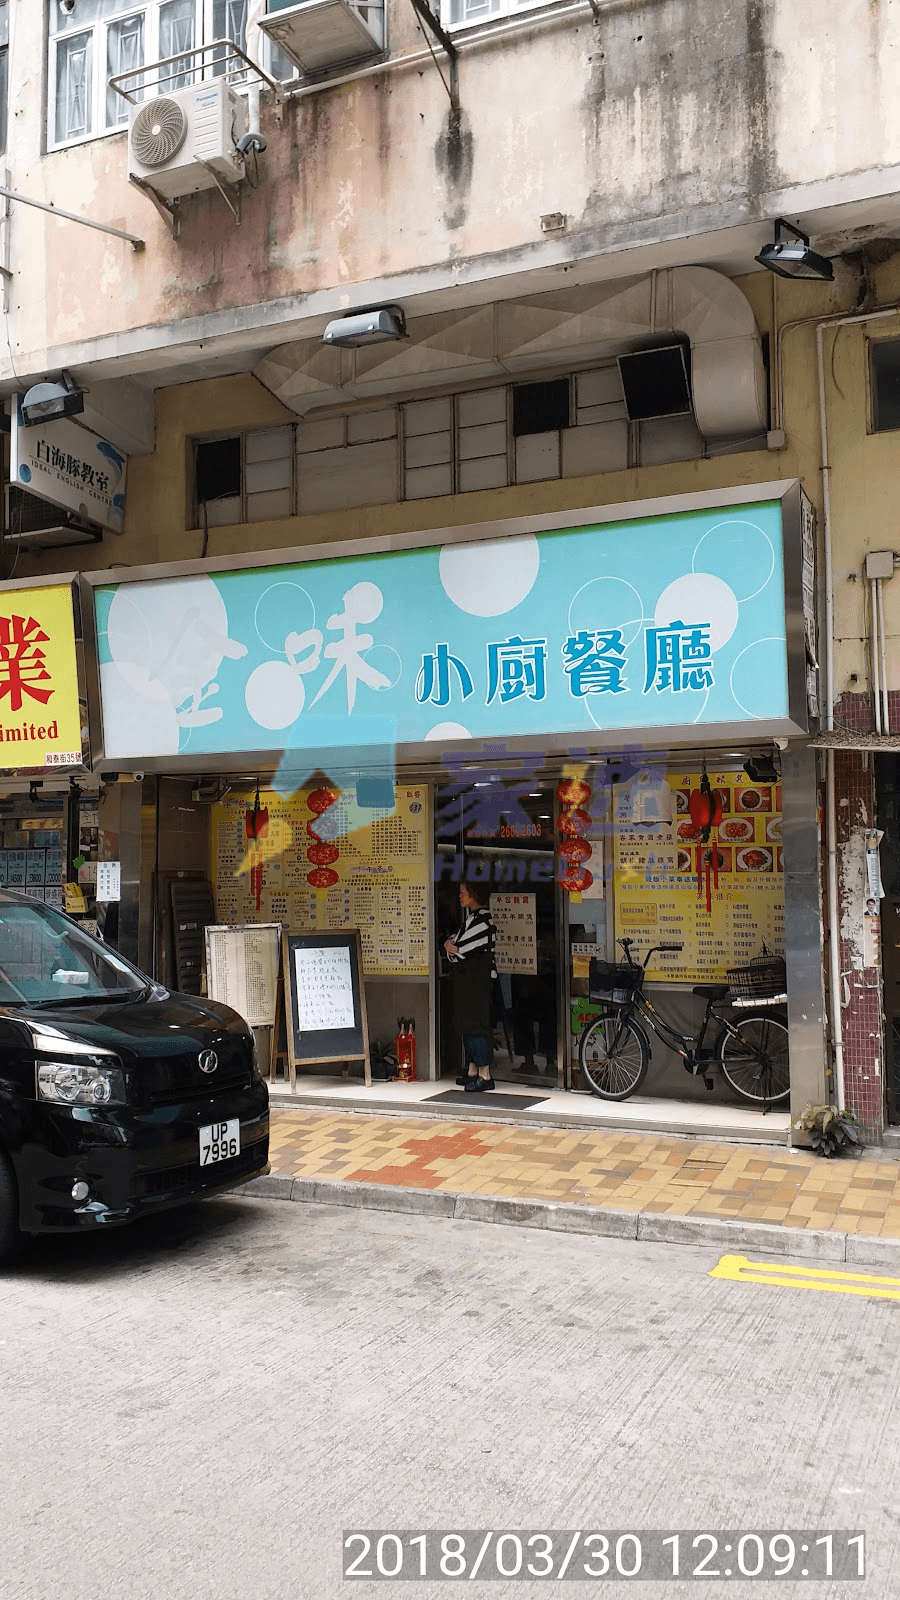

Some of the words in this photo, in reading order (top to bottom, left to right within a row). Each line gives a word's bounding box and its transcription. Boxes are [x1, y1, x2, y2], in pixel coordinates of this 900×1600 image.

[31, 460, 52, 475] IDEAL
[56, 473, 84, 491] ENGLISH
[88, 489, 114, 507] CENTRE
[36, 439, 110, 494] 白海豚教室
[415, 619, 716, 707] 小廚餐廳
[202, 1138, 237, 1165] 7996
[211, 1122, 228, 1143] UP
